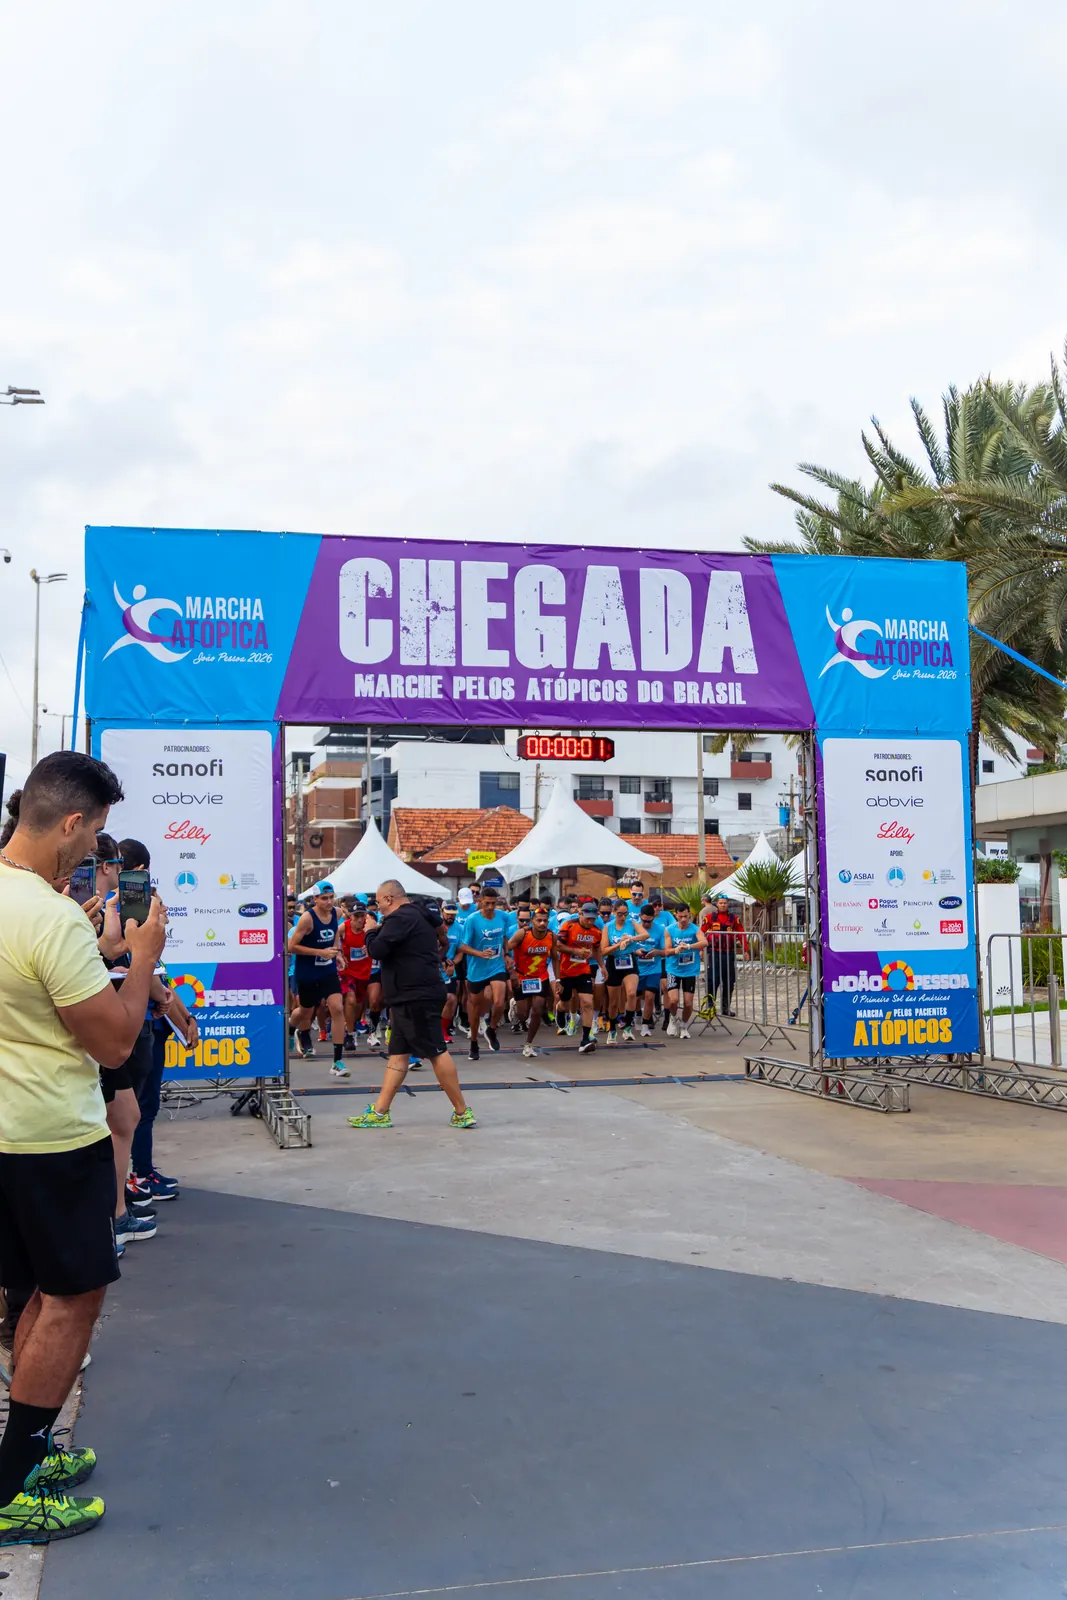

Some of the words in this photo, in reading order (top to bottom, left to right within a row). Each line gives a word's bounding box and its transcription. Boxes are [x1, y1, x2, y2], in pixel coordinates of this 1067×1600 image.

[186, 596, 264, 620] MARCHA
[339, 557, 759, 674] CHEGADA
[171, 614, 269, 649] ATÓPICA
[885, 618, 949, 641] MARCHA
[193, 652, 215, 664] João
[218, 652, 247, 662] Pessoa
[247, 652, 273, 663] 2026
[874, 634, 953, 667] ATÓPICA
[892, 669, 911, 680] João
[912, 669, 935, 679] Pessoa
[937, 670, 957, 679] 2026
[354, 673, 443, 699] MARCHE
[453, 676, 515, 701] PELOS
[526, 671, 628, 702] ATÓPICOS
[638, 679, 664, 703] DO
[674, 681, 747, 705] BRASIL
[163, 745, 211, 753] PATROCINADORES:
[527, 737, 605, 758] 00:00:01
[152, 759, 223, 777] sanofi
[865, 766, 923, 782] sanofi
[152, 792, 223, 805] abbvie
[866, 796, 924, 807] abbvie
[164, 820, 211, 845] Lilly
[877, 821, 915, 844] Lilly
[179, 852, 197, 860] APOIO:
[576, 934, 595, 942] FLASH
[832, 970, 883, 992] JOÃO
[913, 974, 970, 990] PESSOA
[204, 988, 275, 1007] PESSOA
[860, 994, 889, 1003] Primeiro
[892, 994, 903, 1003] Sol
[918, 994, 951, 1002] Américas
[210, 1011, 250, 1020] Américas
[857, 1009, 883, 1018] MARCHA
[894, 1008, 912, 1017] PELOS
[915, 1007, 948, 1016] PACIENTES
[205, 1026, 246, 1036] PACIENTES
[853, 1011, 952, 1046] ATÓPICOS
[164, 1032, 251, 1068] ÓPICOS
